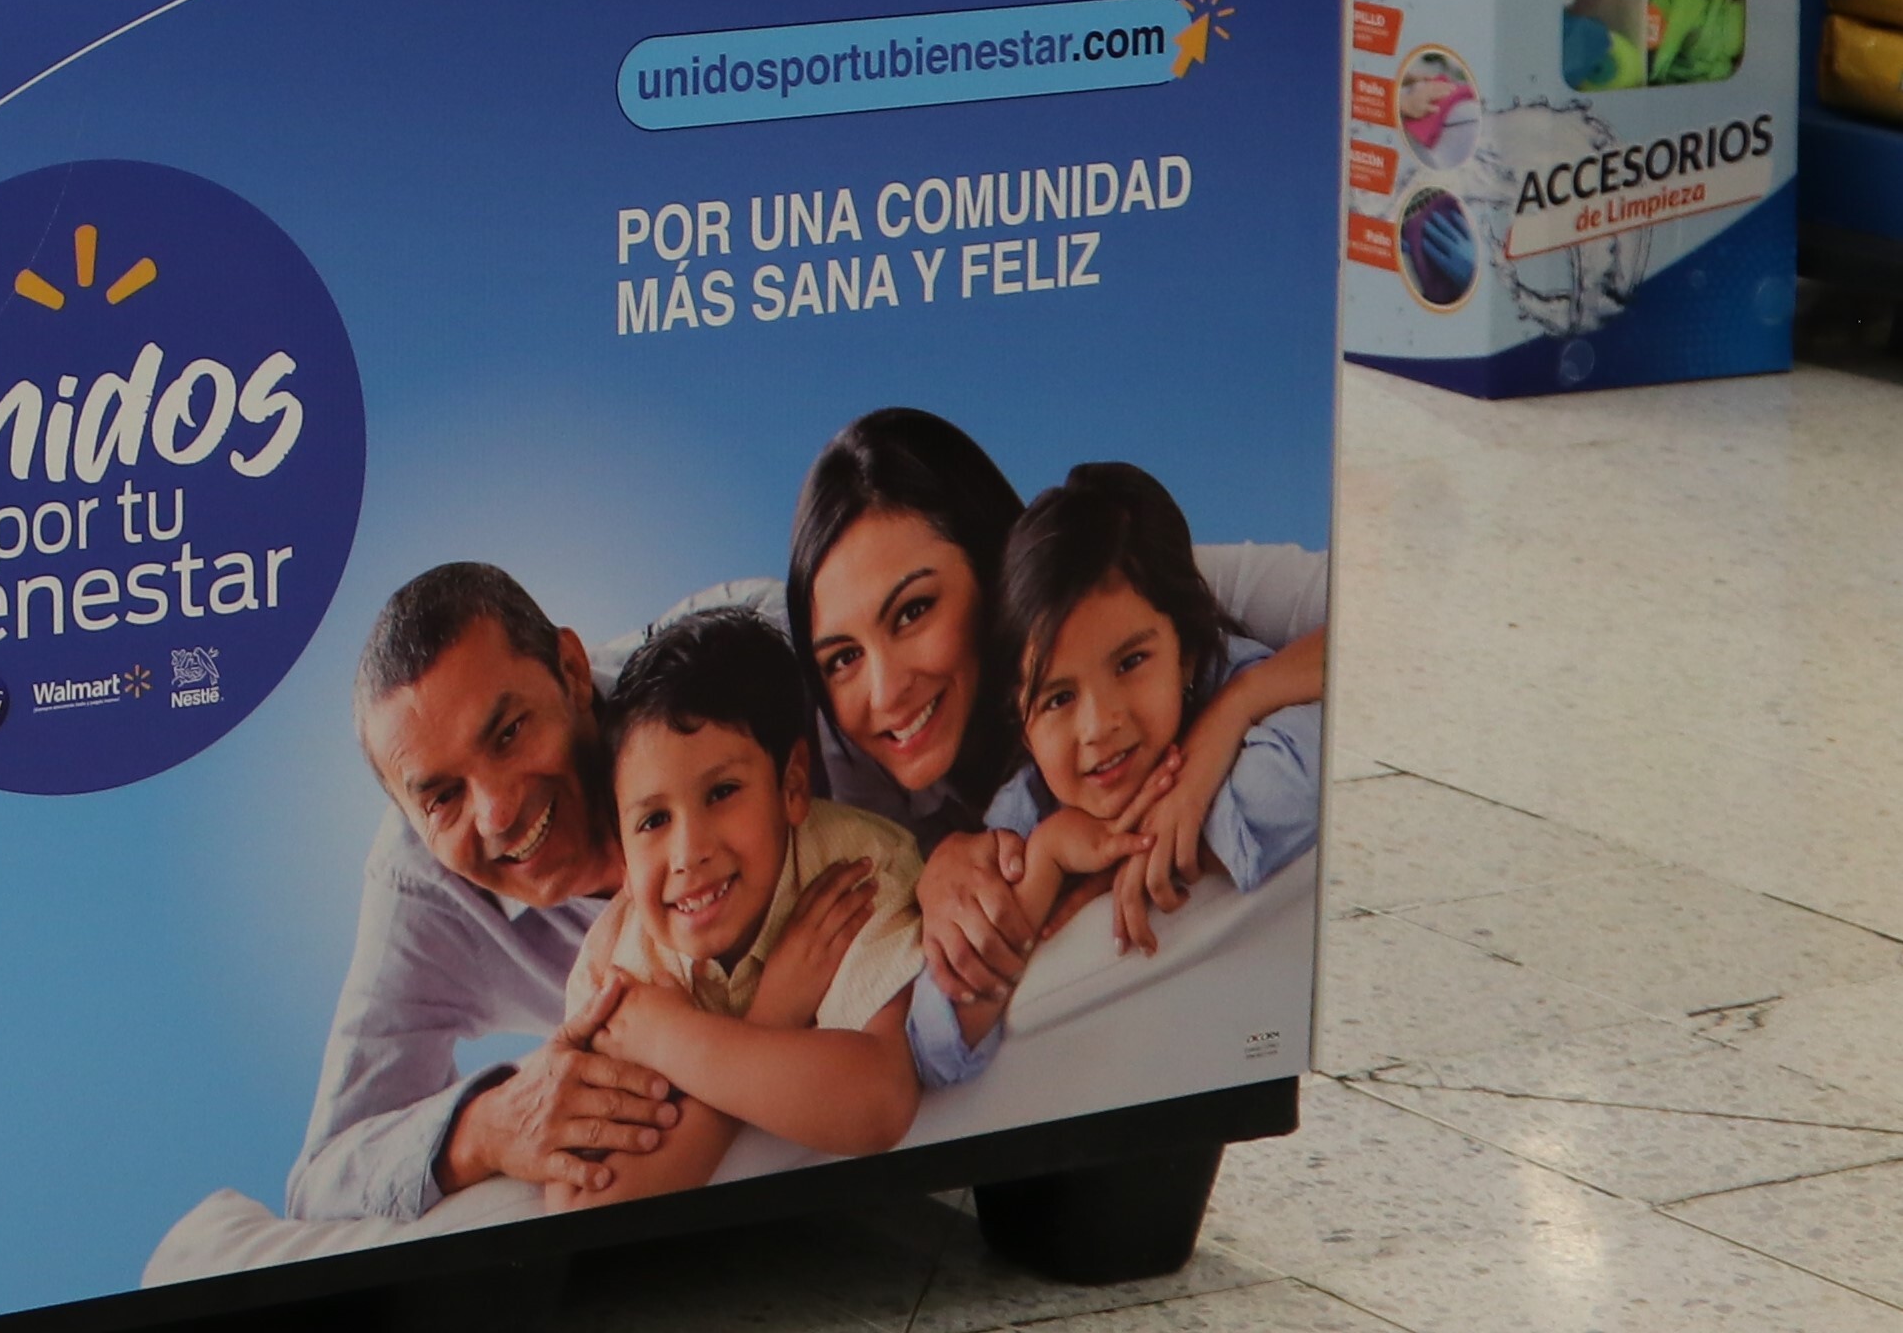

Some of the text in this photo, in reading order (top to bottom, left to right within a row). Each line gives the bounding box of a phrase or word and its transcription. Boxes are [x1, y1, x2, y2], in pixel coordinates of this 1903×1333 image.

[637, 22, 1166, 100] unidosportubienestar.com
[1516, 113, 1773, 214] ACCESORIOS
[618, 155, 1193, 266] POR UNA COMUNIDAD
[1576, 182, 1706, 232] de Limpieza
[618, 231, 1101, 336] MÁS SANA Y FELIZ
[117, 480, 185, 543] tu
[33, 674, 120, 705] Walmart
[171, 686, 219, 709] Nestlé
